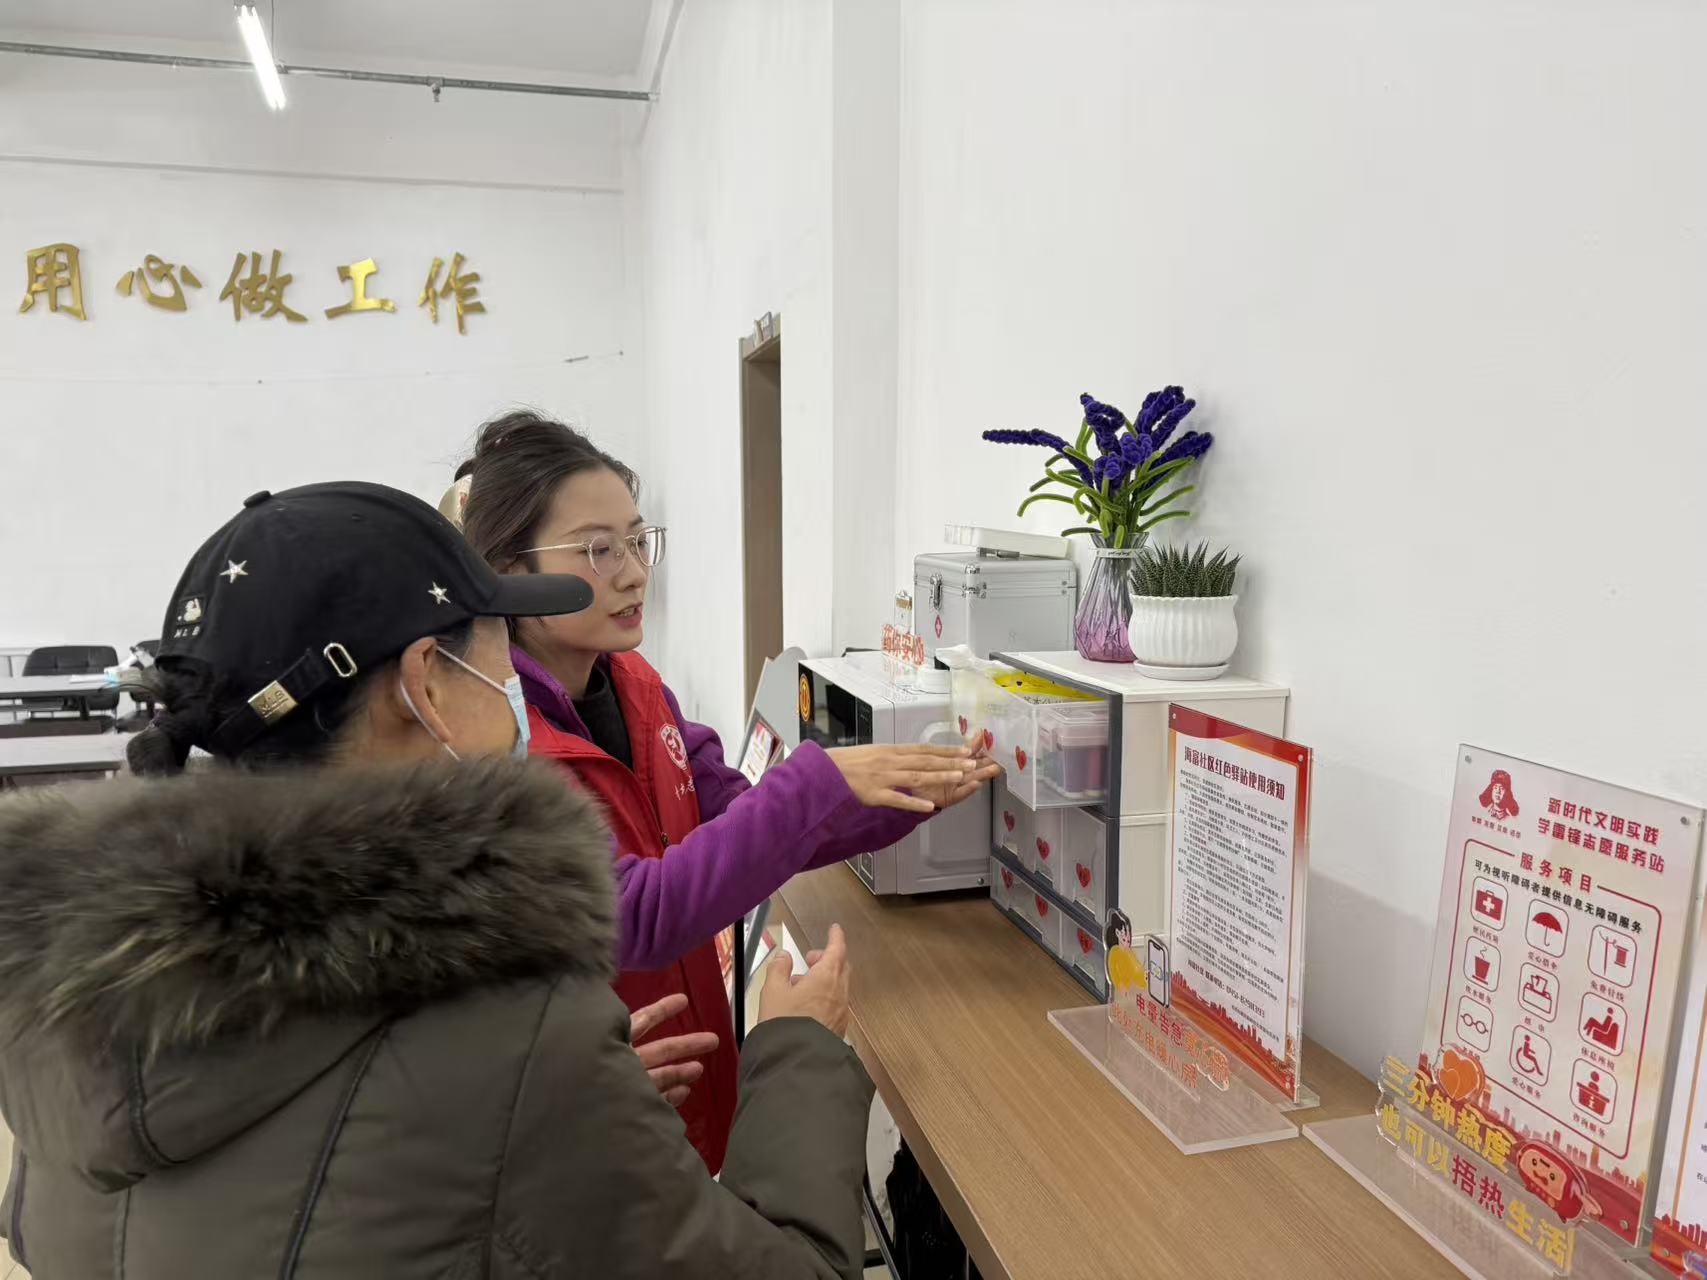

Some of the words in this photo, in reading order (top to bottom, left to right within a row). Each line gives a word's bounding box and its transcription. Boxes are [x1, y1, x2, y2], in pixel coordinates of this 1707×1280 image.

[19, 243, 487, 335] 用心做工作
[174, 626, 200, 638] MLB
[1184, 745, 1285, 801] 海富社区红色驿站使用须知
[1547, 797, 1659, 845] 新时代文明实践
[1537, 818, 1665, 873] 学雷锋志愿服务站
[1474, 859, 1642, 933] 可为视听障碍者提供信息无障碍服务
[1519, 852, 1593, 893] 服务项目
[1589, 979, 1625, 1003] 免费针线
[1581, 1046, 1616, 1071] 休息座椅
[1511, 1076, 1542, 1099] 爱心服务
[1383, 1055, 1513, 1174] 三分钟热度
[1572, 1111, 1607, 1138] 咨询服务
[1381, 1103, 1567, 1270] 也可以捂热生活
